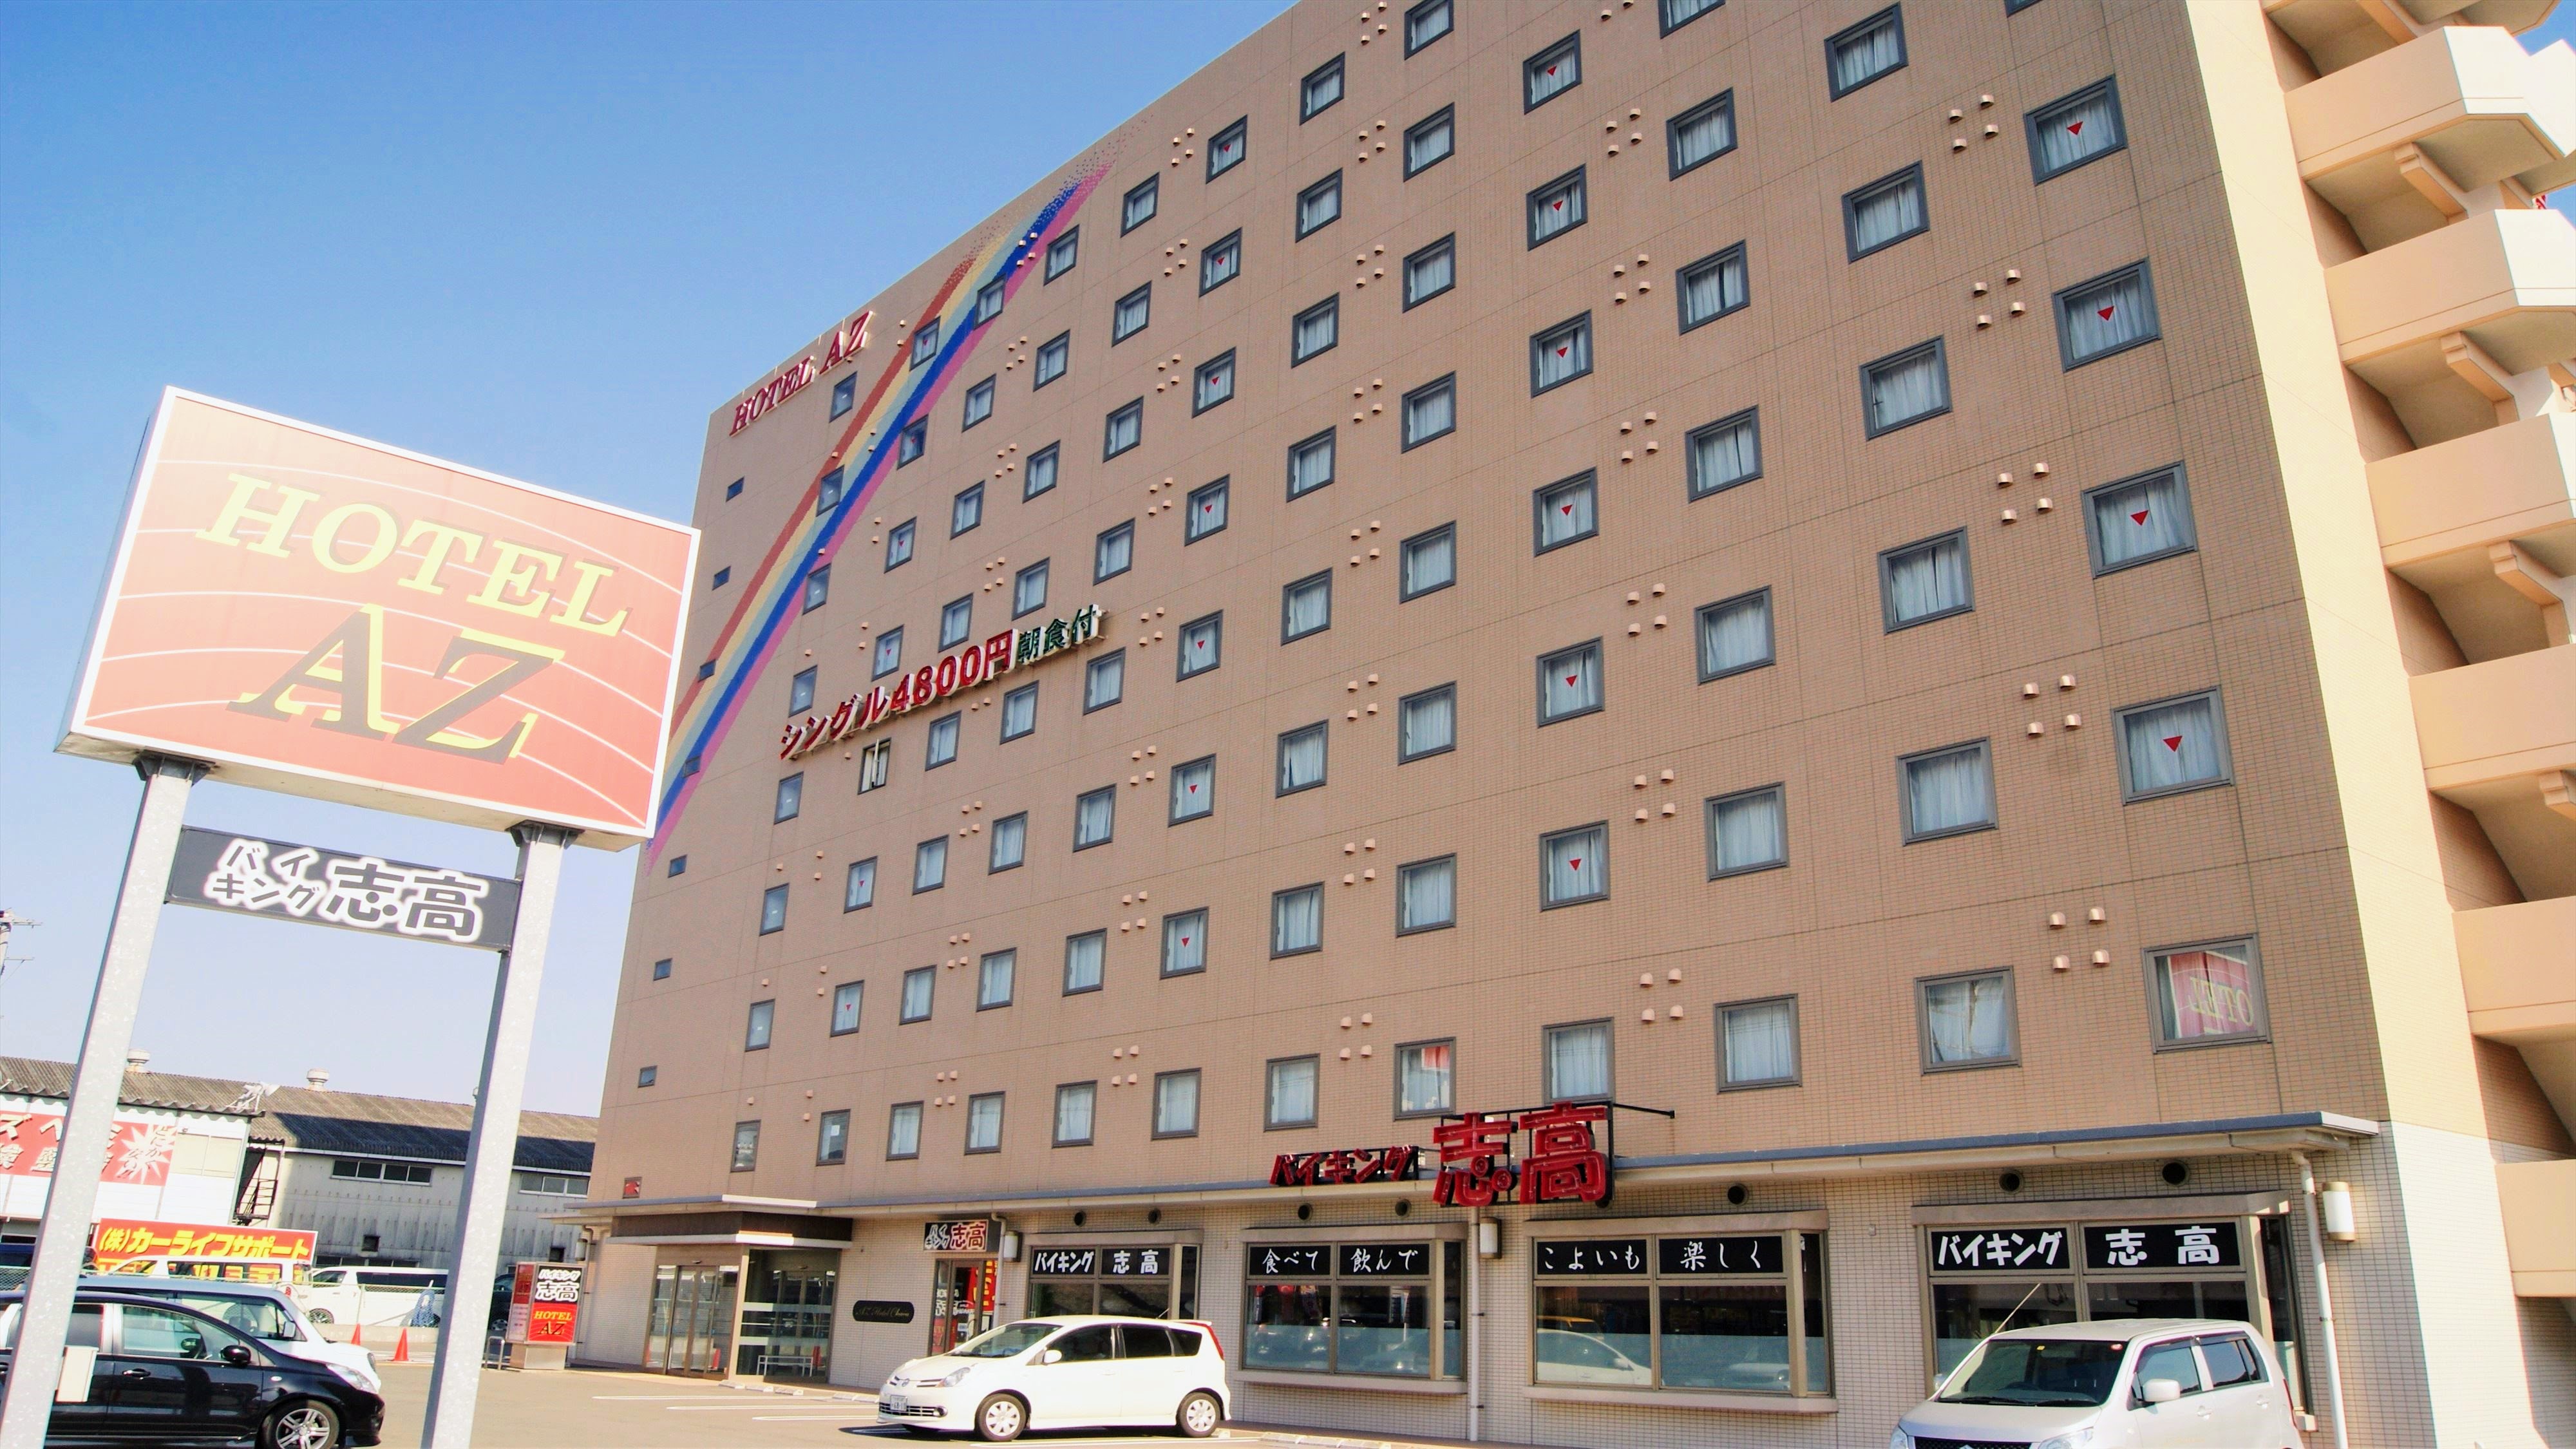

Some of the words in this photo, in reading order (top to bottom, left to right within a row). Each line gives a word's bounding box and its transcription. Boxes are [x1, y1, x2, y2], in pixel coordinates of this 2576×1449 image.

[729, 355, 815, 436] HOTEL
[819, 310, 874, 375] AZ
[195, 472, 634, 637] HOTEL
[225, 602, 566, 765] AZ
[323, 860, 484, 939] 志高
[1269, 1144, 1419, 1186] バイキング
[1432, 1101, 1613, 1208] 志高
[951, 1223, 986, 1249] 志高
[1937, 1231, 2063, 1266] バイキング
[1034, 1251, 1095, 1274] バイキング
[1112, 1250, 1159, 1274] 志高
[1262, 1248, 1318, 1274] 食べて
[1350, 1248, 1419, 1273] 飲んで
[1680, 1240, 1761, 1271] 楽しく
[539, 1269, 581, 1281] バイキング
[535, 1281, 579, 1302] 志高
[534, 1311, 573, 1320] HOTEL
[538, 1321, 567, 1335] AZ
